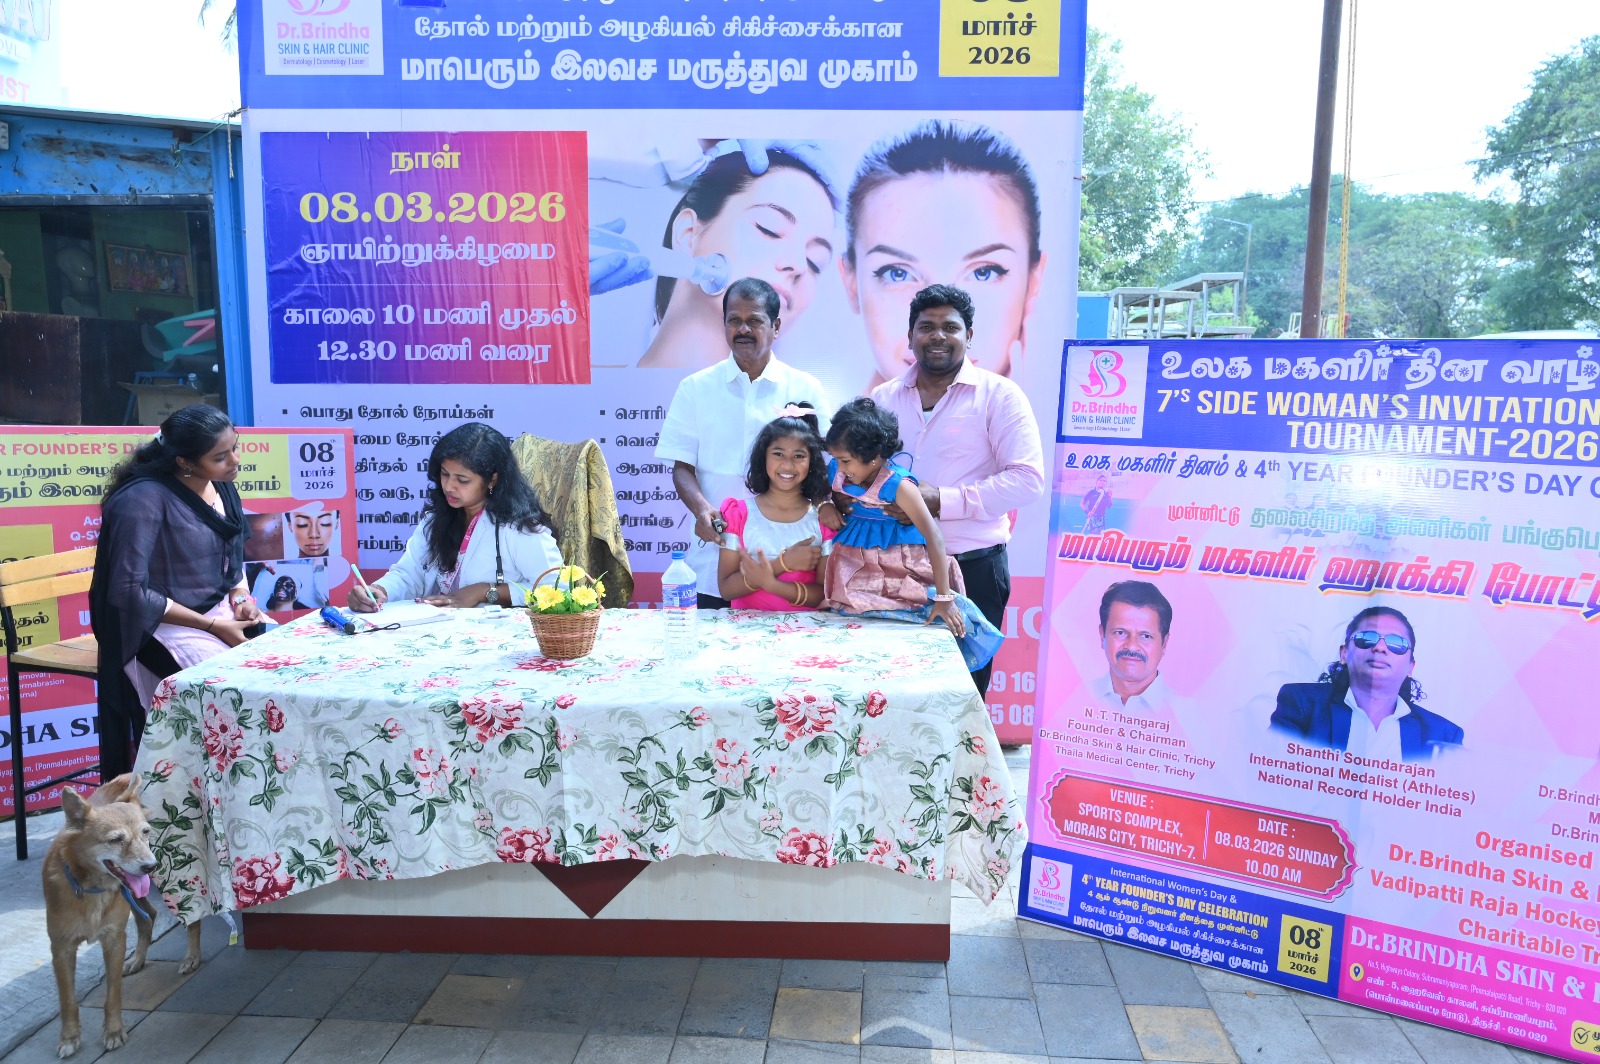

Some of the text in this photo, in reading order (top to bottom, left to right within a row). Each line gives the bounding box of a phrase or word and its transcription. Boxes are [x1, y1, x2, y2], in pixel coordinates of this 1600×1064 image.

[277, 22, 370, 39] Dr.Brindha
[414, 14, 903, 42] தோல் மற்றும் அழகியல் சிகிச்சைக்கான
[962, 12, 1037, 37] மார்ச்
[278, 43, 370, 54] SKIN & HAIR CLINIC
[968, 46, 1031, 65] 2026
[401, 49, 918, 94] மாபெரும் இலவச மருத்துவ முகாம்
[390, 144, 461, 175] நாள்
[299, 192, 566, 223] 08.03.2026
[300, 234, 556, 267] ஞாயிற்றுக்கிழமை
[283, 300, 577, 331] காலை 10 மணி முதல்
[318, 337, 552, 364] 12.30 மணி வரை
[1161, 350, 1252, 380] உலக
[1264, 344, 1394, 382] மகளிர்
[1404, 347, 1489, 391] தின
[300, 403, 494, 422] பொது தோல் நோய்கள்
[1071, 414, 1136, 425] SKIN & HAIR CLINIC
[1072, 401, 1138, 415] Dr.Brindha
[1197, 389, 1258, 415] SIDE
[1266, 391, 1409, 420] WOMAN'S
[1418, 394, 1600, 426] INVITATION
[12, 442, 118, 456] FOUNDER'S
[1287, 421, 1599, 461] TOURNAMENT-2026
[7, 463, 72, 480] மற்றும்
[300, 466, 336, 478] மார்ச்
[304, 480, 334, 490] 2026
[1065, 450, 1583, 497] உலக மகளிர் தினம் & 4th YEAR DAY
[379, 486, 415, 501] வடு,
[1167, 501, 1492, 542] முன்னிட்டு தலைசிறந்த அணிகள்
[1058, 530, 1476, 597] மாபெரும் மகளிர் ஹாக்கி
[1067, 718, 1186, 748] Founder & Chairman
[1084, 708, 1171, 733] N Thangaraj
[1039, 729, 1216, 769] Dr.Brindha Skin & Hair Clinic, Trichy
[1055, 745, 1195, 780] Thaila Medical Center, Trichy
[1286, 742, 1436, 778] Shanthi Soundarajan
[1249, 752, 1476, 805] International Medalist (Athletes)
[1257, 770, 1462, 818] National Record Holder India
[1109, 788, 1147, 808] VENUE
[1078, 802, 1184, 837] SPORTS COMPLEX,
[1258, 817, 1289, 837] DATE
[1063, 818, 1196, 860] MORAIS CITY, TRICHY-7.
[1215, 830, 1338, 869] 08.03.2026 SUNDAY
[1475, 831, 1593, 869] Organised
[1110, 867, 1237, 904] International Women's Day &
[1244, 858, 1302, 883] 10.00 AM
[1389, 843, 1590, 901] Dr.Brindha Skin &
[1095, 877, 1119, 892] YEAR
[1121, 882, 1174, 906] FOUNDER'S
[1176, 896, 1197, 911] DAY
[1198, 900, 1269, 928] CELEBRATION
[1370, 869, 1464, 904] Vadipatti
[1469, 889, 1519, 916] Raja
[1079, 901, 1108, 916] தோல்
[1109, 911, 1144, 926] மற்றும்
[1146, 919, 1191, 937] அழகியல்
[1192, 929, 1264, 955] சிகிச்சைக்கான
[1458, 917, 1575, 959] Charitable
[1073, 915, 1269, 974] மாபெரும் இலவச மருத்துவ முகாம்
[1287, 949, 1320, 964] மார்ச்
[1289, 962, 1317, 975] 2026
[1350, 925, 1586, 1000] Dr.BRINDHA SKIN &
[1507, 1025, 1527, 1037] 620
[1528, 1030, 1548, 1043] 020
